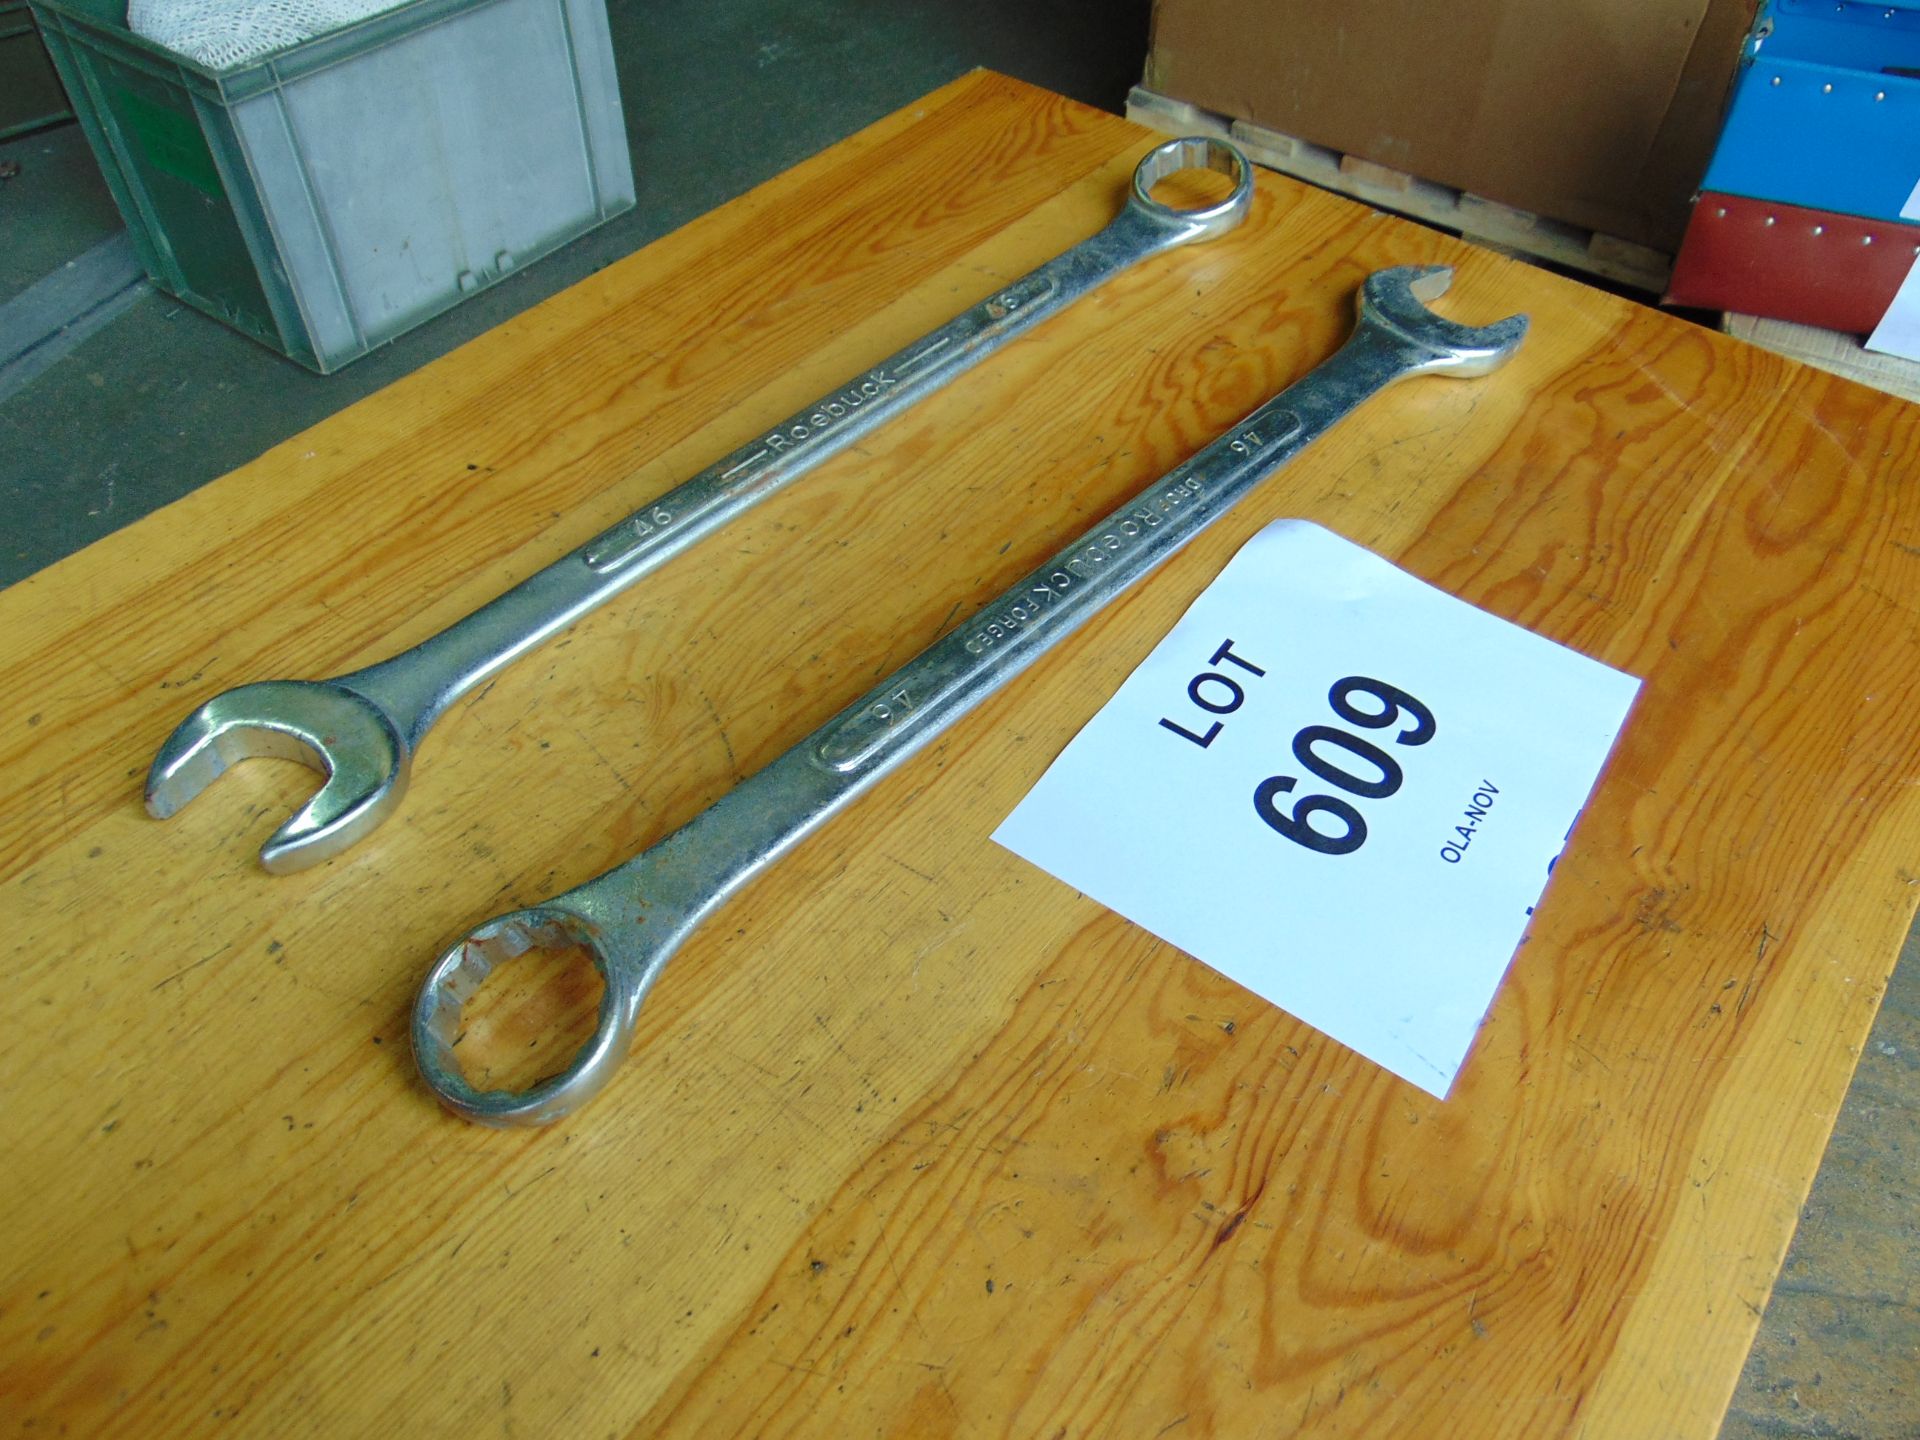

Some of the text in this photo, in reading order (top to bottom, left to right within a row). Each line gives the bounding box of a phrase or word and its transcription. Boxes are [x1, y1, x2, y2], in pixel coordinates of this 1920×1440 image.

[767, 370, 896, 453] Roebuck
[1229, 430, 1263, 456] 46
[633, 506, 672, 538] 46
[1034, 507, 1160, 603] Roebuck
[965, 598, 1041, 654] FORGED
[870, 688, 914, 728] 46
[1158, 638, 1267, 749] LOT
[1253, 675, 1437, 855] 609
[1440, 779, 1500, 864] OLA-NOV
